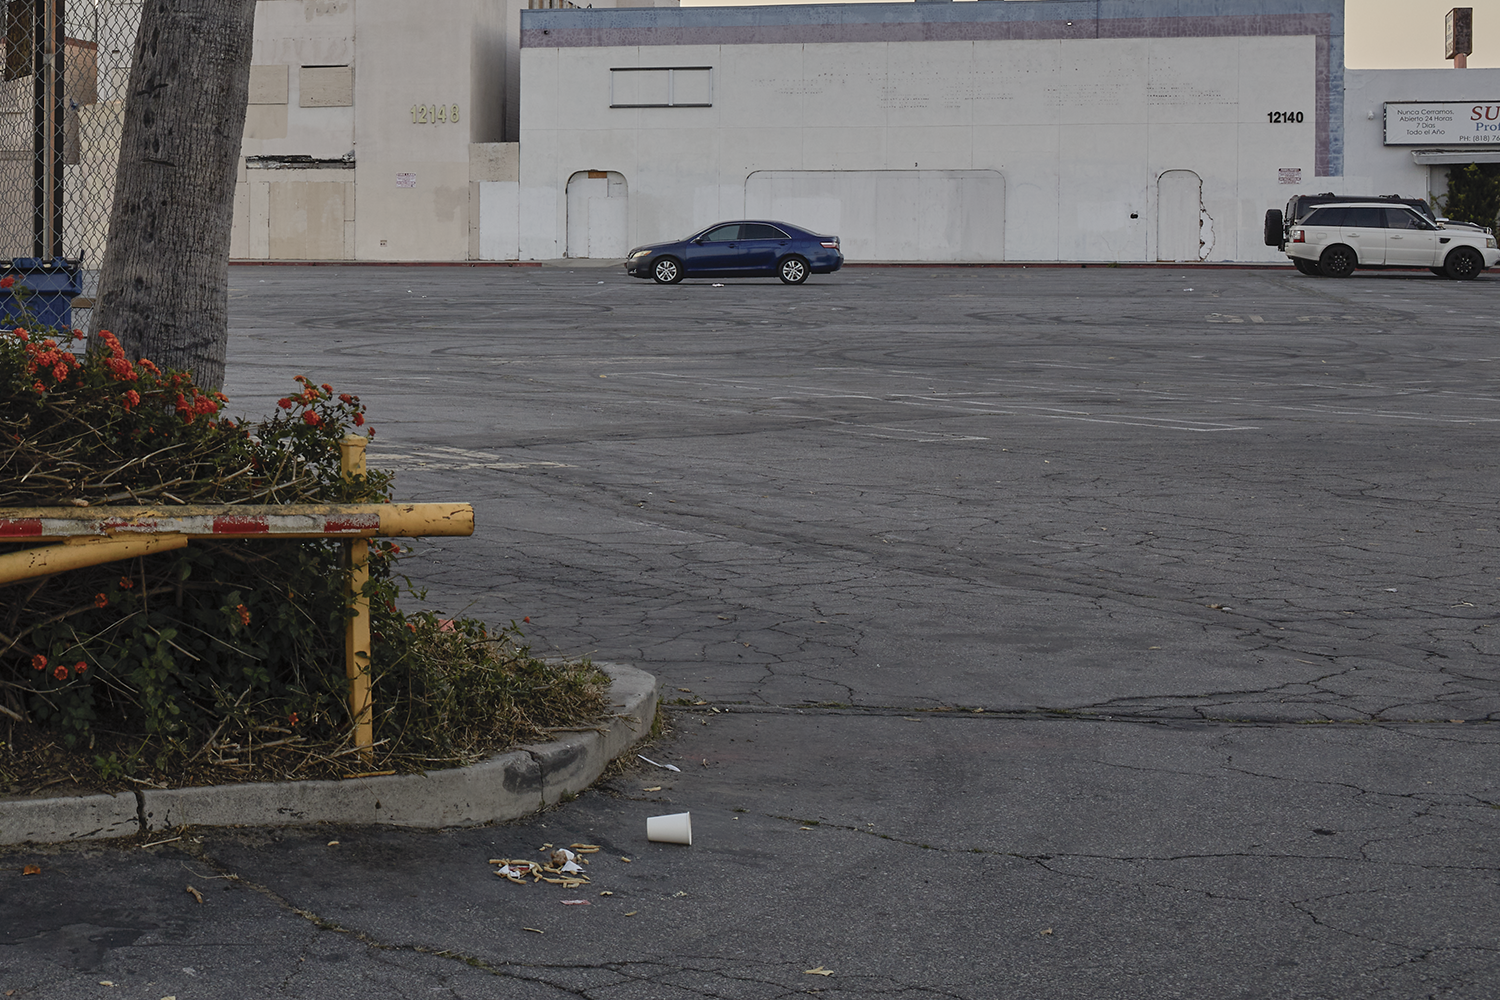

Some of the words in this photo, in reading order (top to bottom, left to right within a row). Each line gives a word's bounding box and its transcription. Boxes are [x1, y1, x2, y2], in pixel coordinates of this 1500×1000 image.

[410, 103, 460, 124] 12148
[1267, 111, 1304, 124] 12140
[1470, 105, 1500, 121] SU
